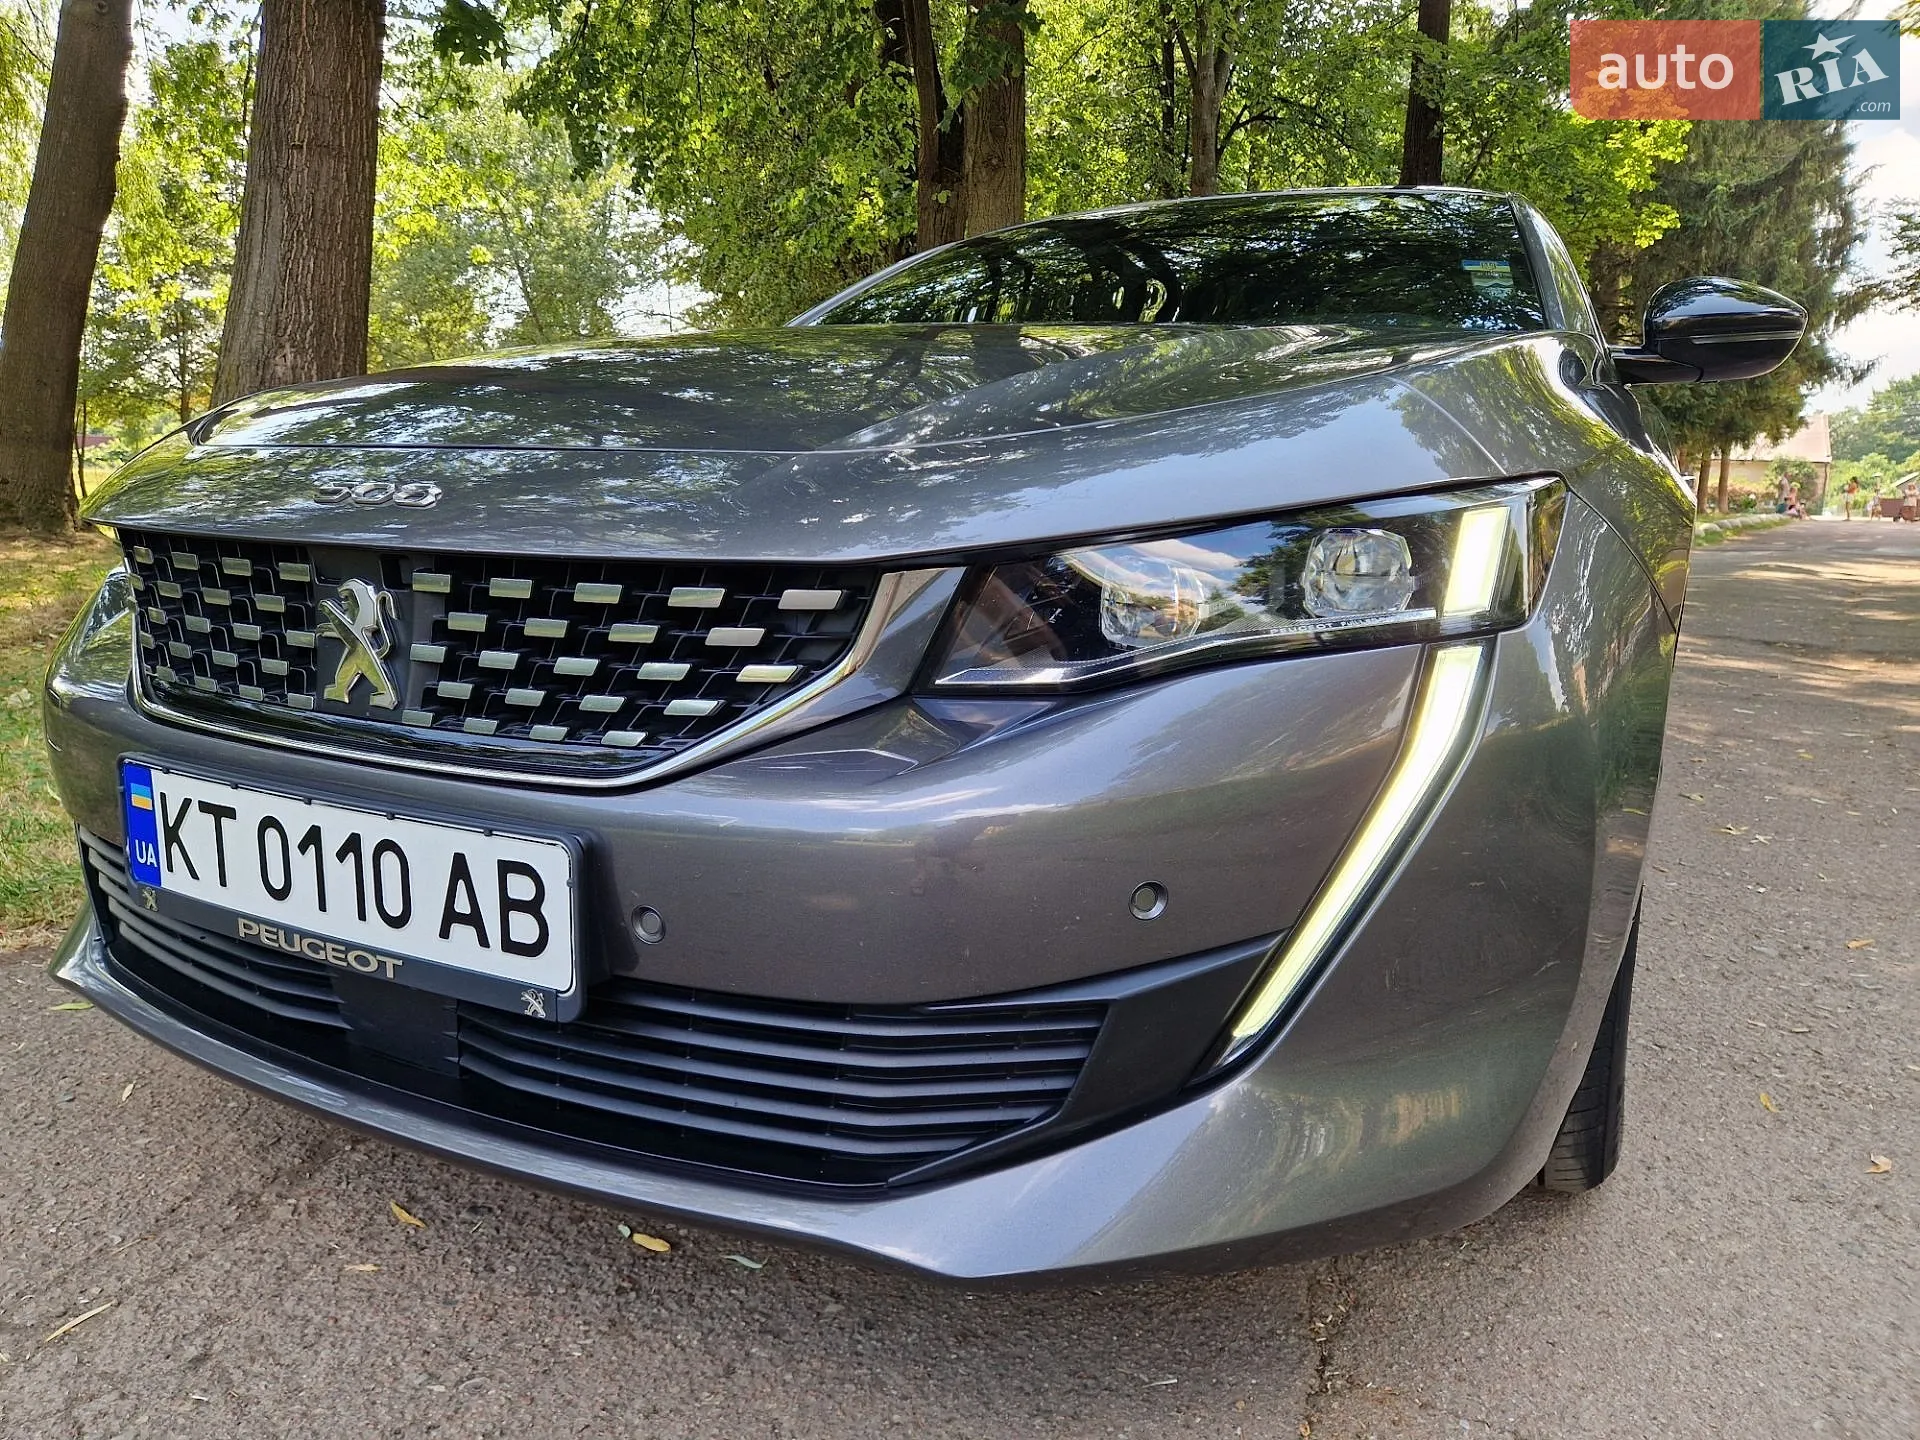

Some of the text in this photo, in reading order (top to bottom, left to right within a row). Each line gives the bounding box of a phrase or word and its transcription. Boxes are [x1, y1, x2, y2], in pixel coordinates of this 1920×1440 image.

[135, 840, 158, 869] UA
[159, 791, 550, 958] KT 0110 AB
[237, 917, 404, 980] PEUGEOT
